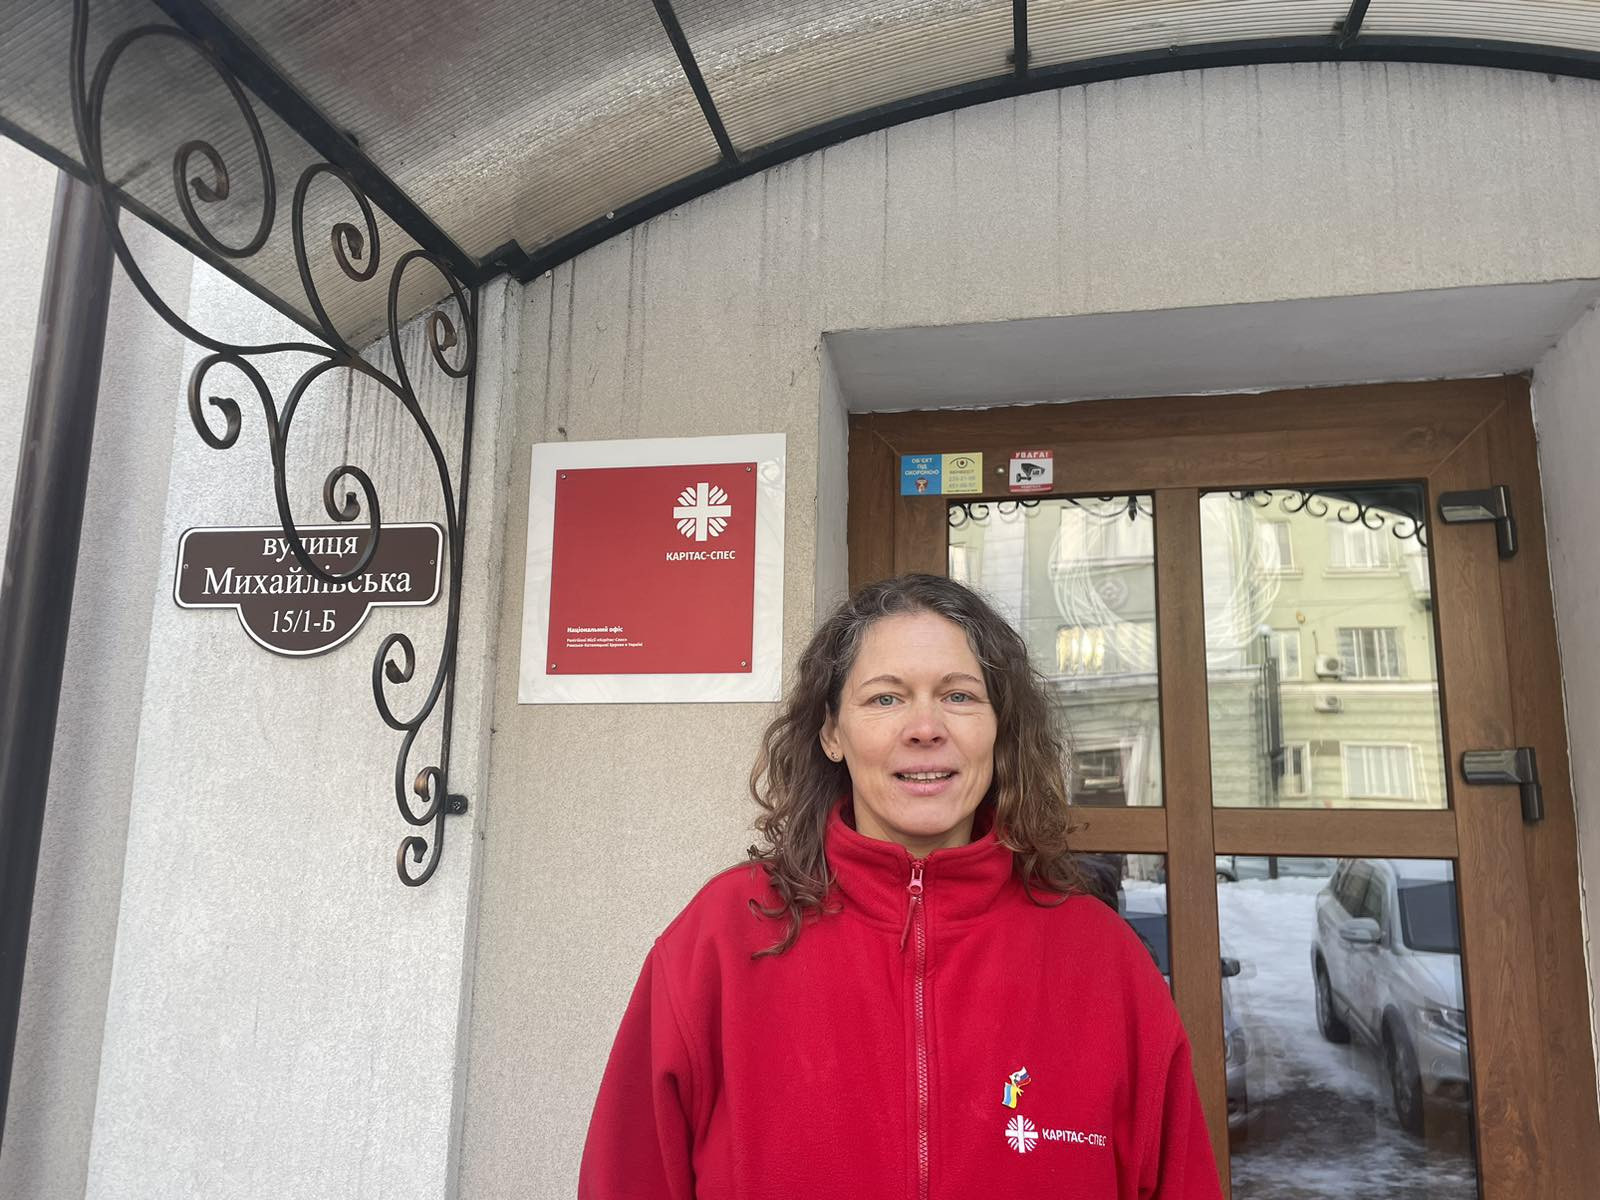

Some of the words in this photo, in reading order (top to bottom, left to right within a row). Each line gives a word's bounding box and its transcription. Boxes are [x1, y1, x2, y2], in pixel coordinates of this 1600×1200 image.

[1015, 451, 1049, 459] УВАГА!
[666, 550, 736, 562] КАРІТАС-СПЕС
[271, 609, 336, 633] 15/1-Б
[1042, 1128, 1106, 1146] КАРІТАС-СПЕС
